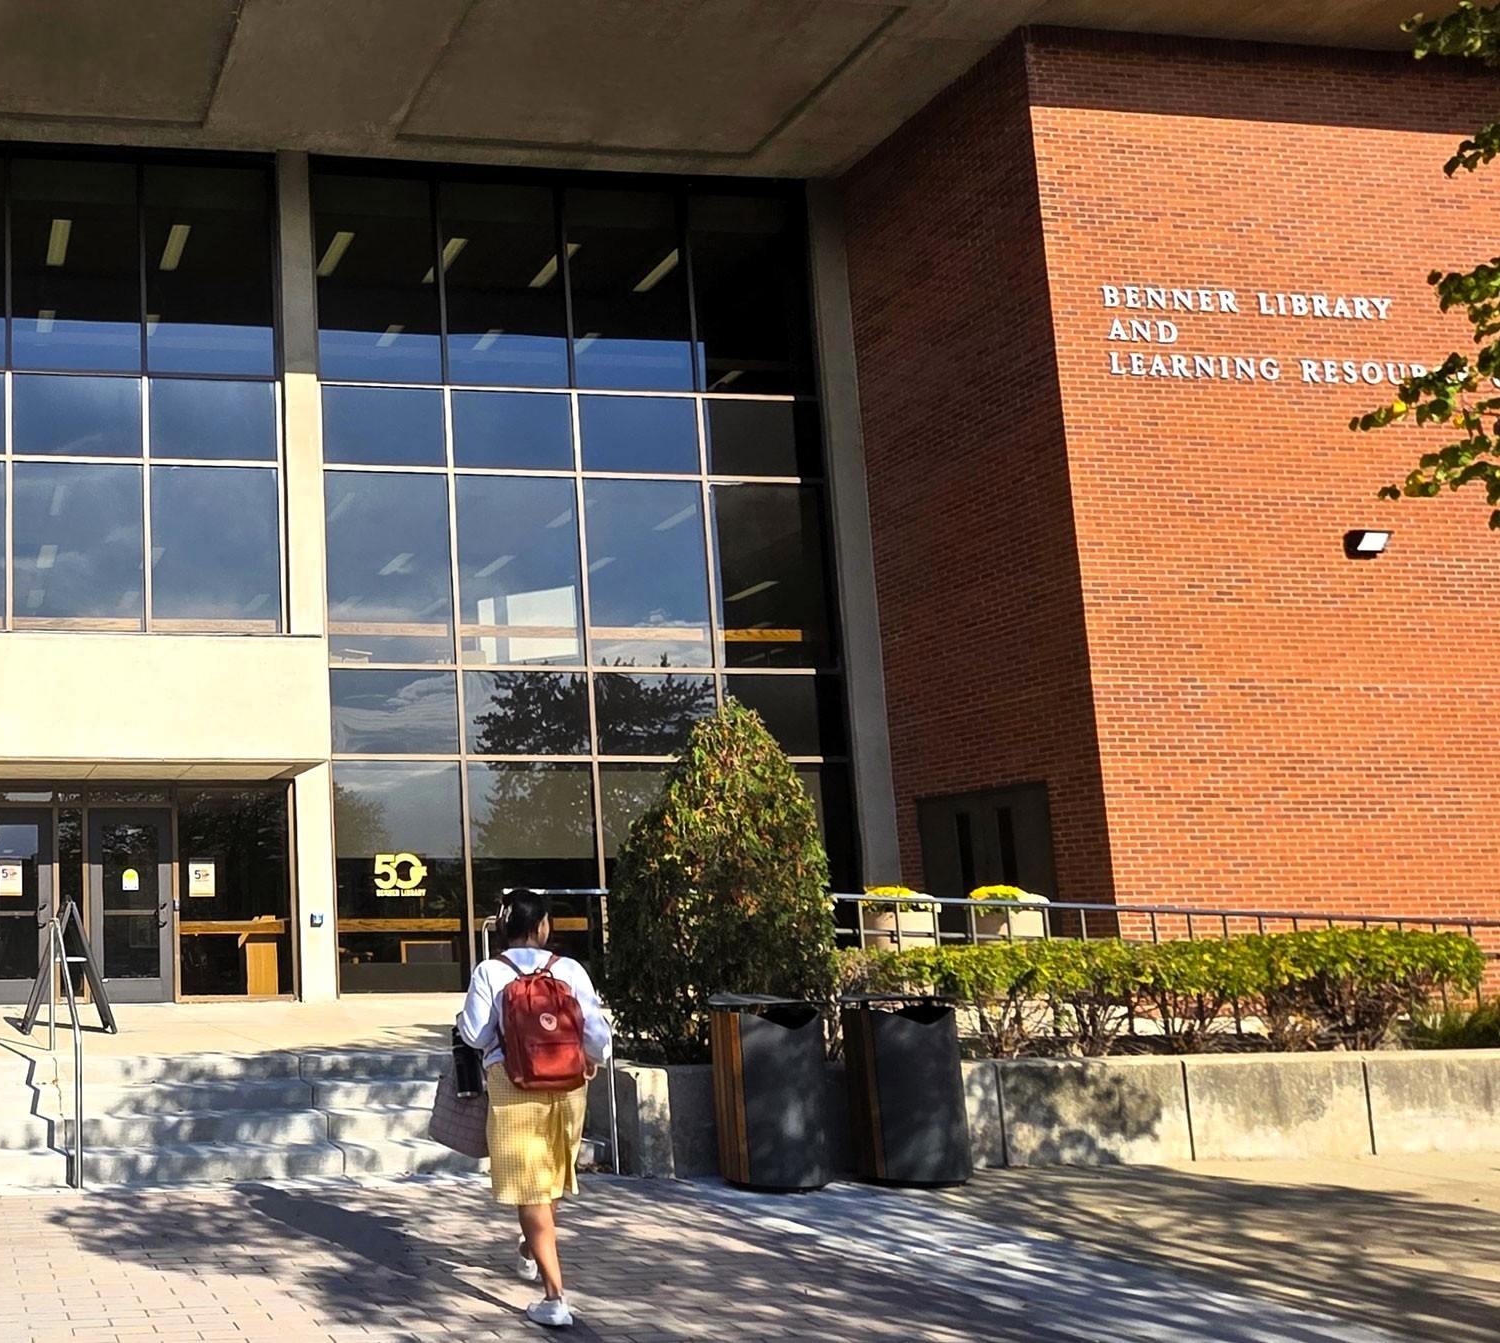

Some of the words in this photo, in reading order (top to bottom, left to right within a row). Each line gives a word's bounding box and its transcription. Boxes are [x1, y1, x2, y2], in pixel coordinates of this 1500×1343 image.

[1100, 285, 1240, 313] BENNER
[1256, 292, 1393, 321] LIBRARY
[1107, 318, 1179, 344] AND
[1109, 351, 1280, 382] LEARNING
[1300, 358, 1468, 387] RESOUR
[374, 852, 428, 889] 50
